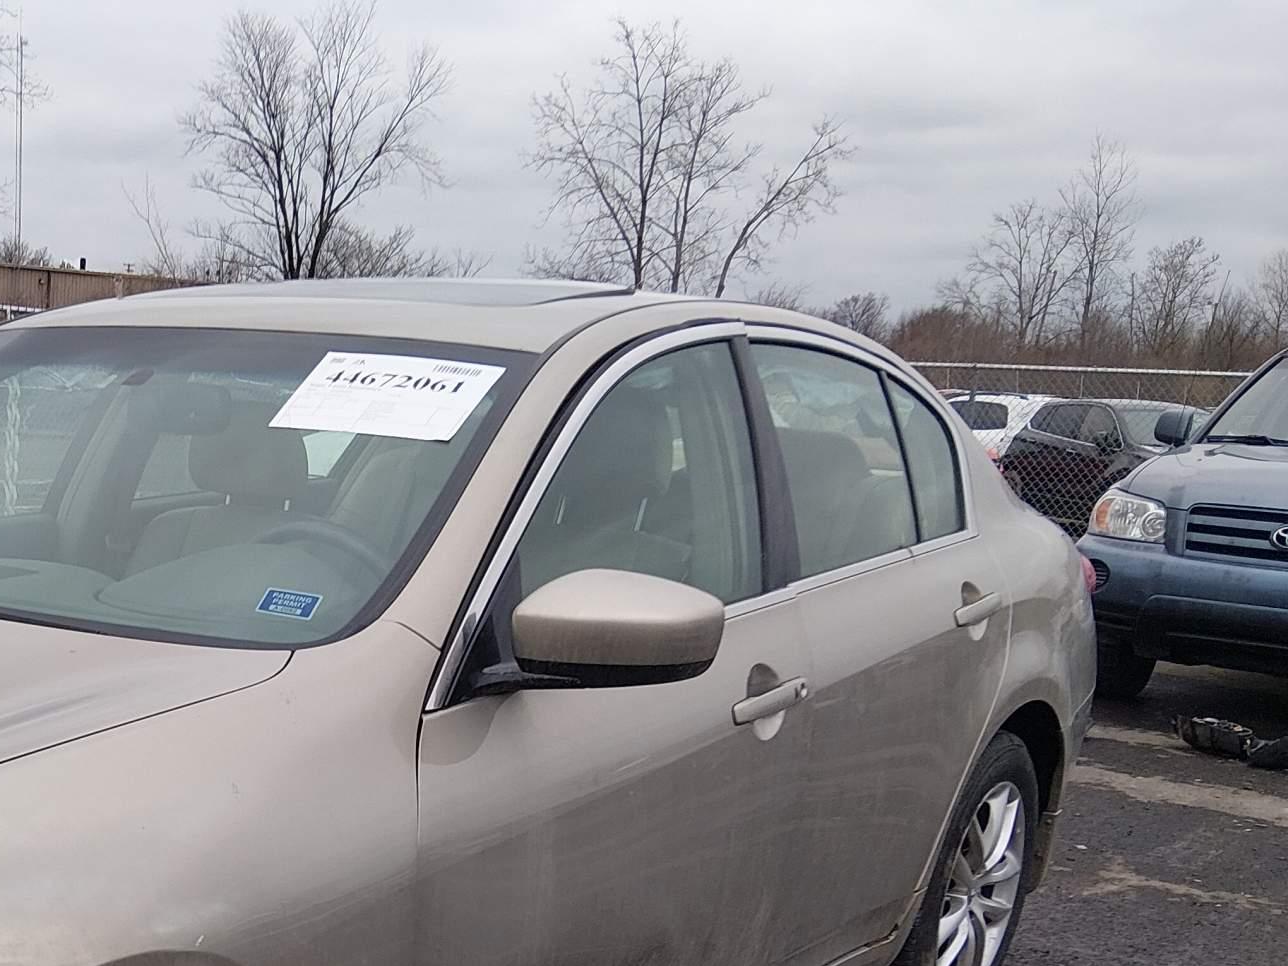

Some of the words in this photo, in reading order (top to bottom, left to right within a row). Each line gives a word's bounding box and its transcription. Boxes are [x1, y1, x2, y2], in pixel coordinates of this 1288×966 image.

[325, 369, 465, 393] 44672061
[272, 592, 312, 604] PARKING
[272, 598, 306, 609] PERMIT
